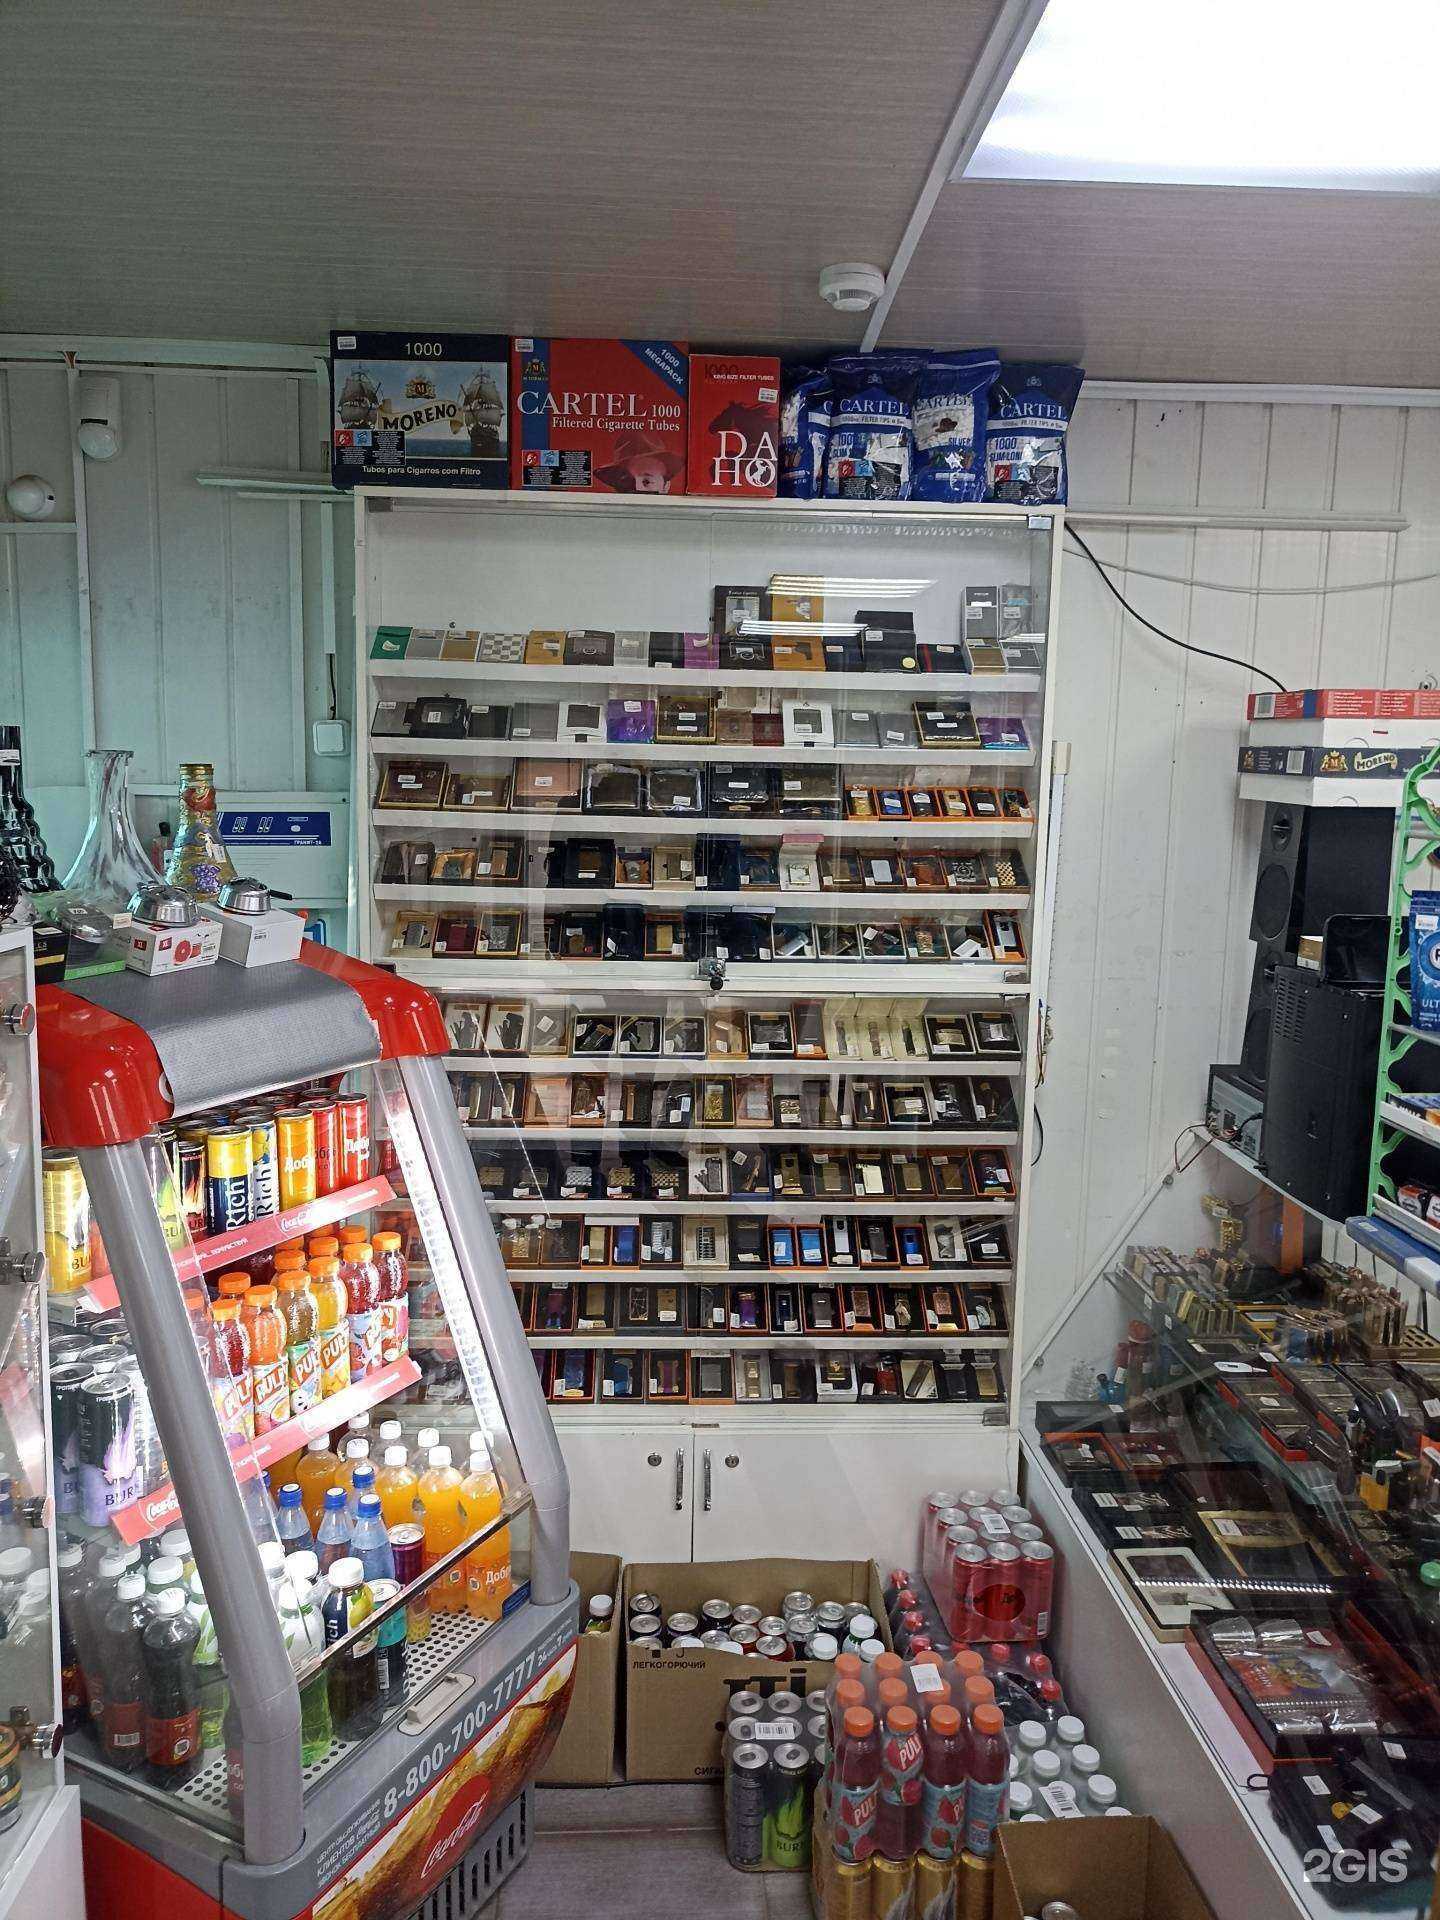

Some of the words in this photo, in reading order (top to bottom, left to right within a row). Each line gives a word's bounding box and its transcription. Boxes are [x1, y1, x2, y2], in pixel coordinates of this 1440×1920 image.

[405, 342, 443, 356] 1000
[660, 348, 680, 367] 1000
[644, 347, 684, 385] MEGAPACK
[517, 390, 647, 417] CARTEL
[651, 404, 681, 418] 1000
[840, 398, 910, 416] CARTEL
[1000, 402, 1068, 420] CARTEL
[381, 404, 457, 432] MORENO
[552, 417, 593, 429] Filtered
[597, 418, 645, 432] Cigarette
[648, 419, 680, 431] Tubes
[362, 466, 386, 474] Tubos
[406, 466, 440, 476] Cigarros
[460, 467, 481, 476] Filtro
[1356, 754, 1395, 770] MORENO
[1422, 998, 1440, 1008] ULT
[256, 1164, 274, 1217] Rich
[226, 1178, 246, 1232] Rich
[328, 1618, 339, 1648] ich
[632, 1660, 706, 1670] ЛЕГКОГОРЮЧИЙ
[384, 1650, 535, 1818] 8-800-700-7777
